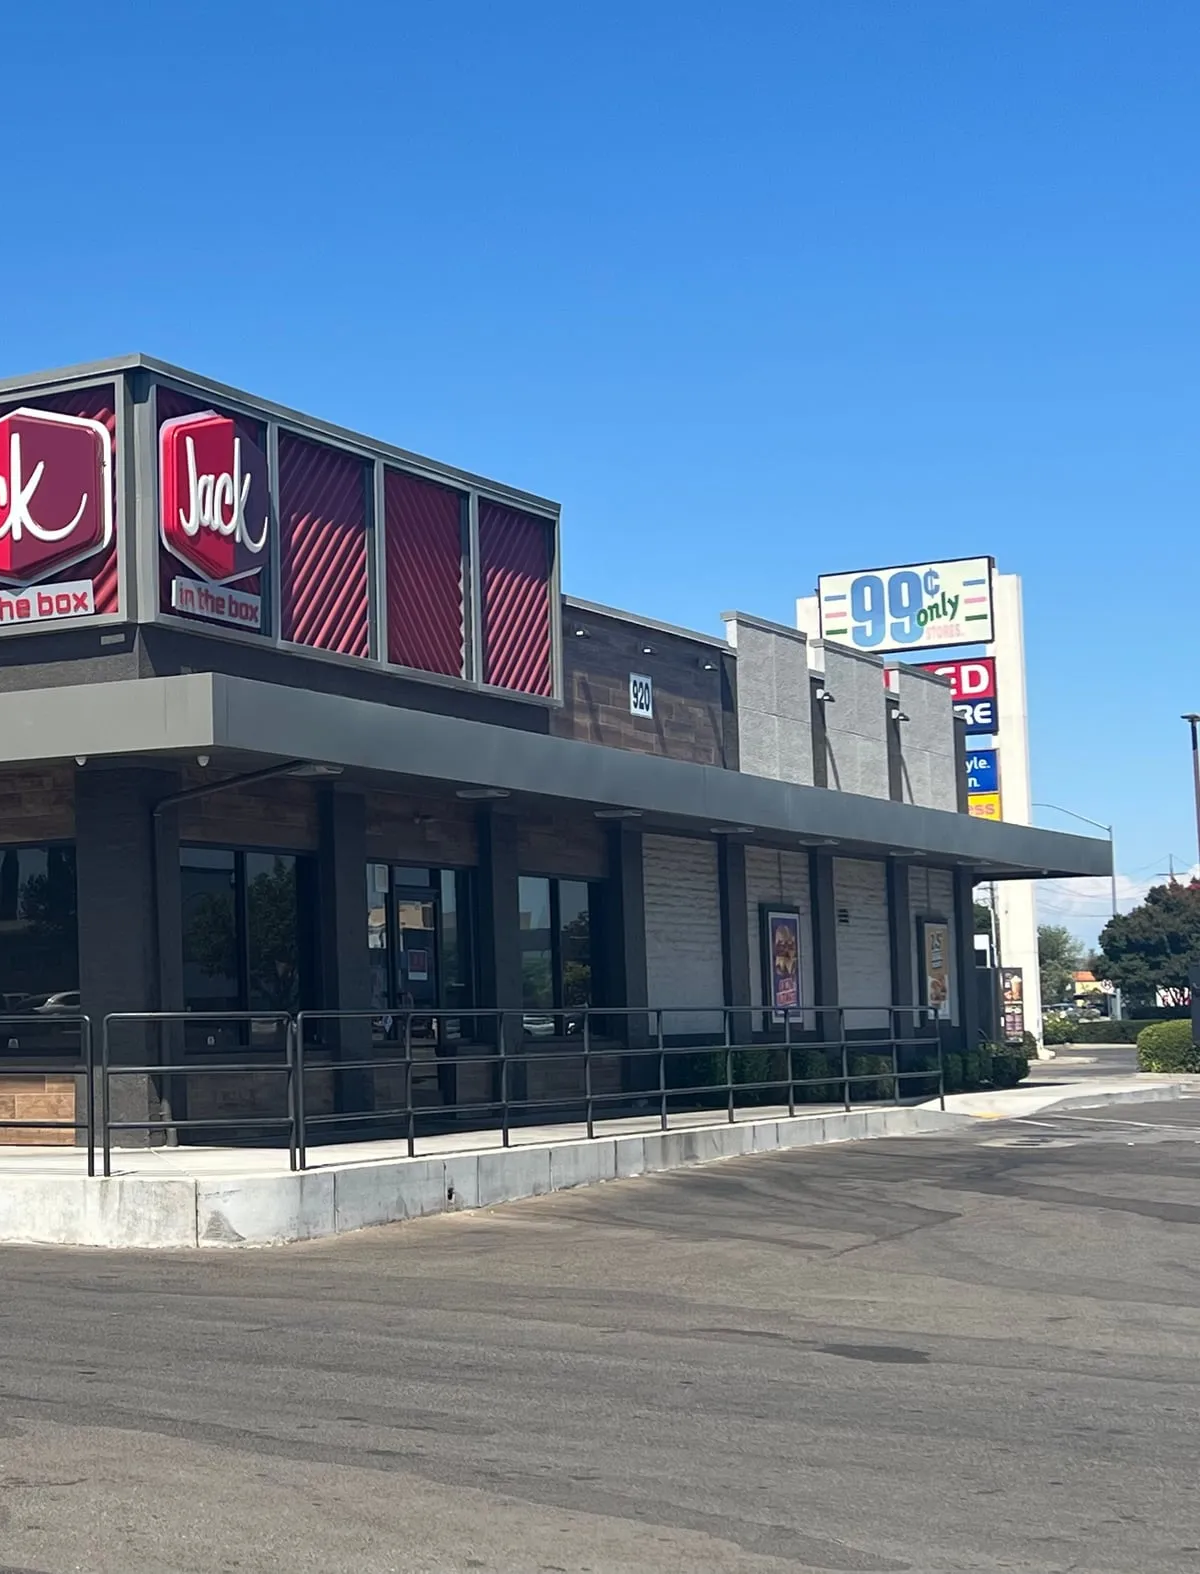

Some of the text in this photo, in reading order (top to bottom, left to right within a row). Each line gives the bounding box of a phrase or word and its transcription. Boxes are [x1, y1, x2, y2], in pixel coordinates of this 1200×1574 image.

[179, 435, 268, 554] Jack
[37, 591, 89, 617] box
[180, 582, 259, 622] in the box
[916, 591, 960, 627] only
[632, 680, 650, 711] 920
